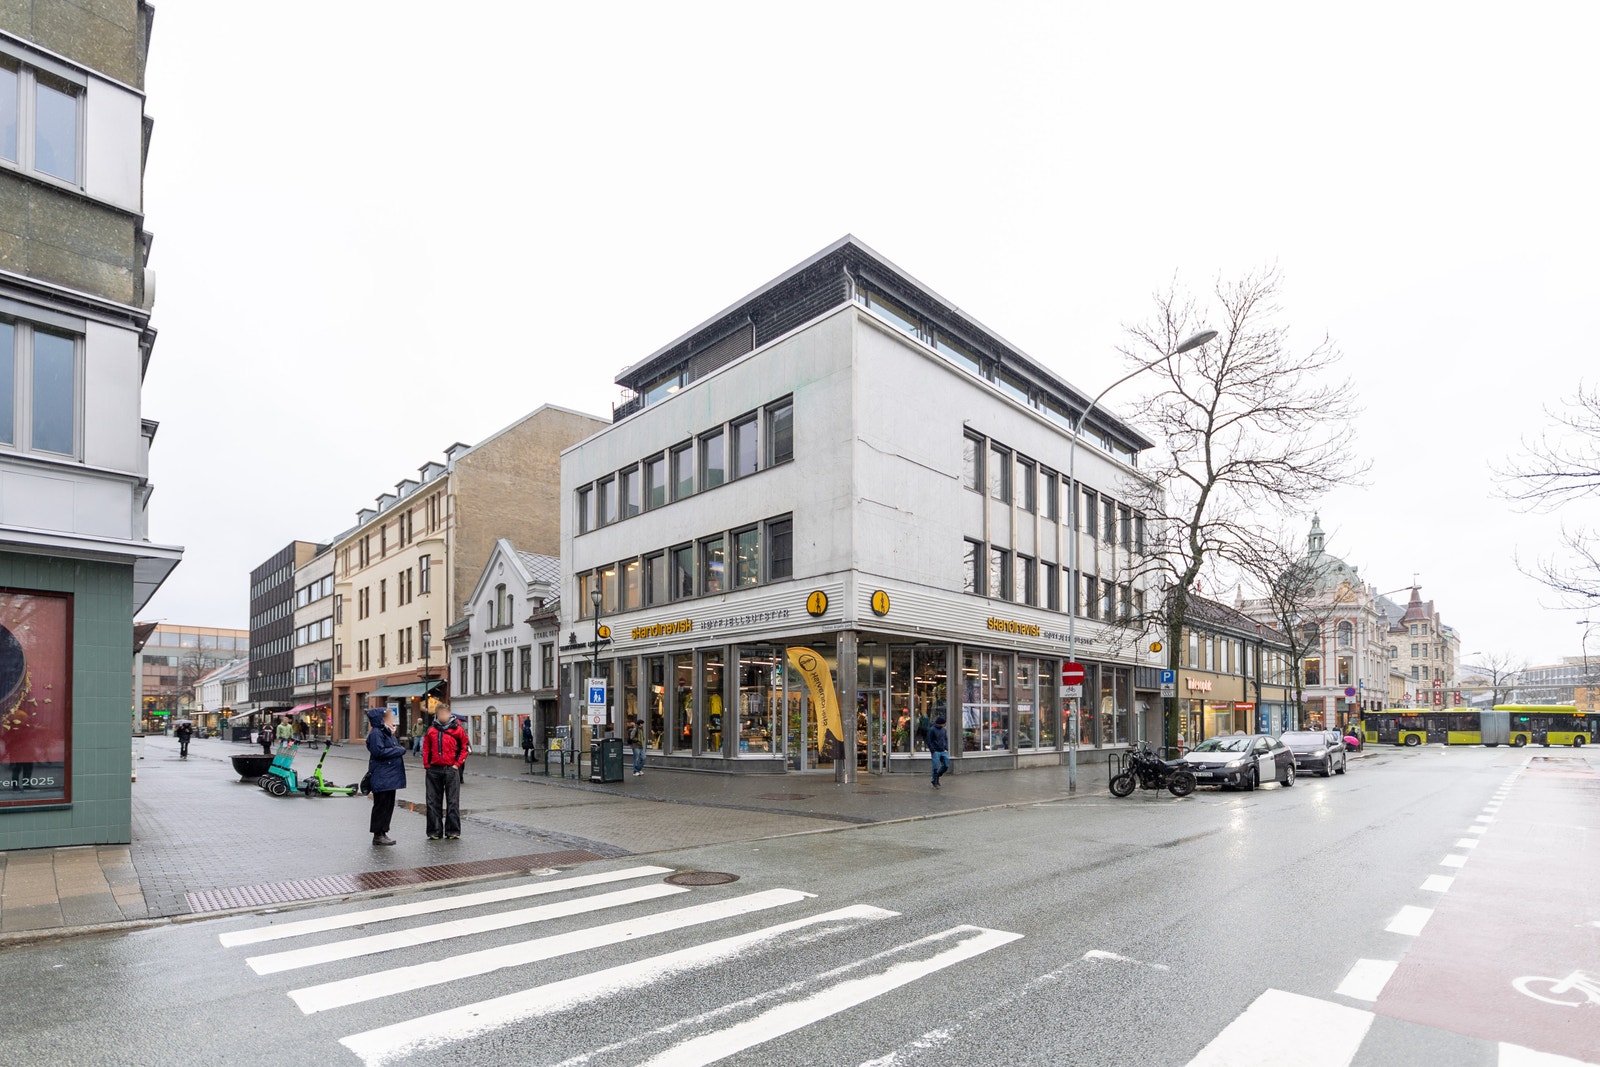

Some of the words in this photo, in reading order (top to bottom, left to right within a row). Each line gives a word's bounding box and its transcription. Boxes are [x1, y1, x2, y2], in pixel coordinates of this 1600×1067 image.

[631, 618, 693, 640] skandinavisk
[987, 617, 1040, 637] skandinavisk
[1163, 671, 1171, 682] P
[22, 777, 55, 786] 2025
